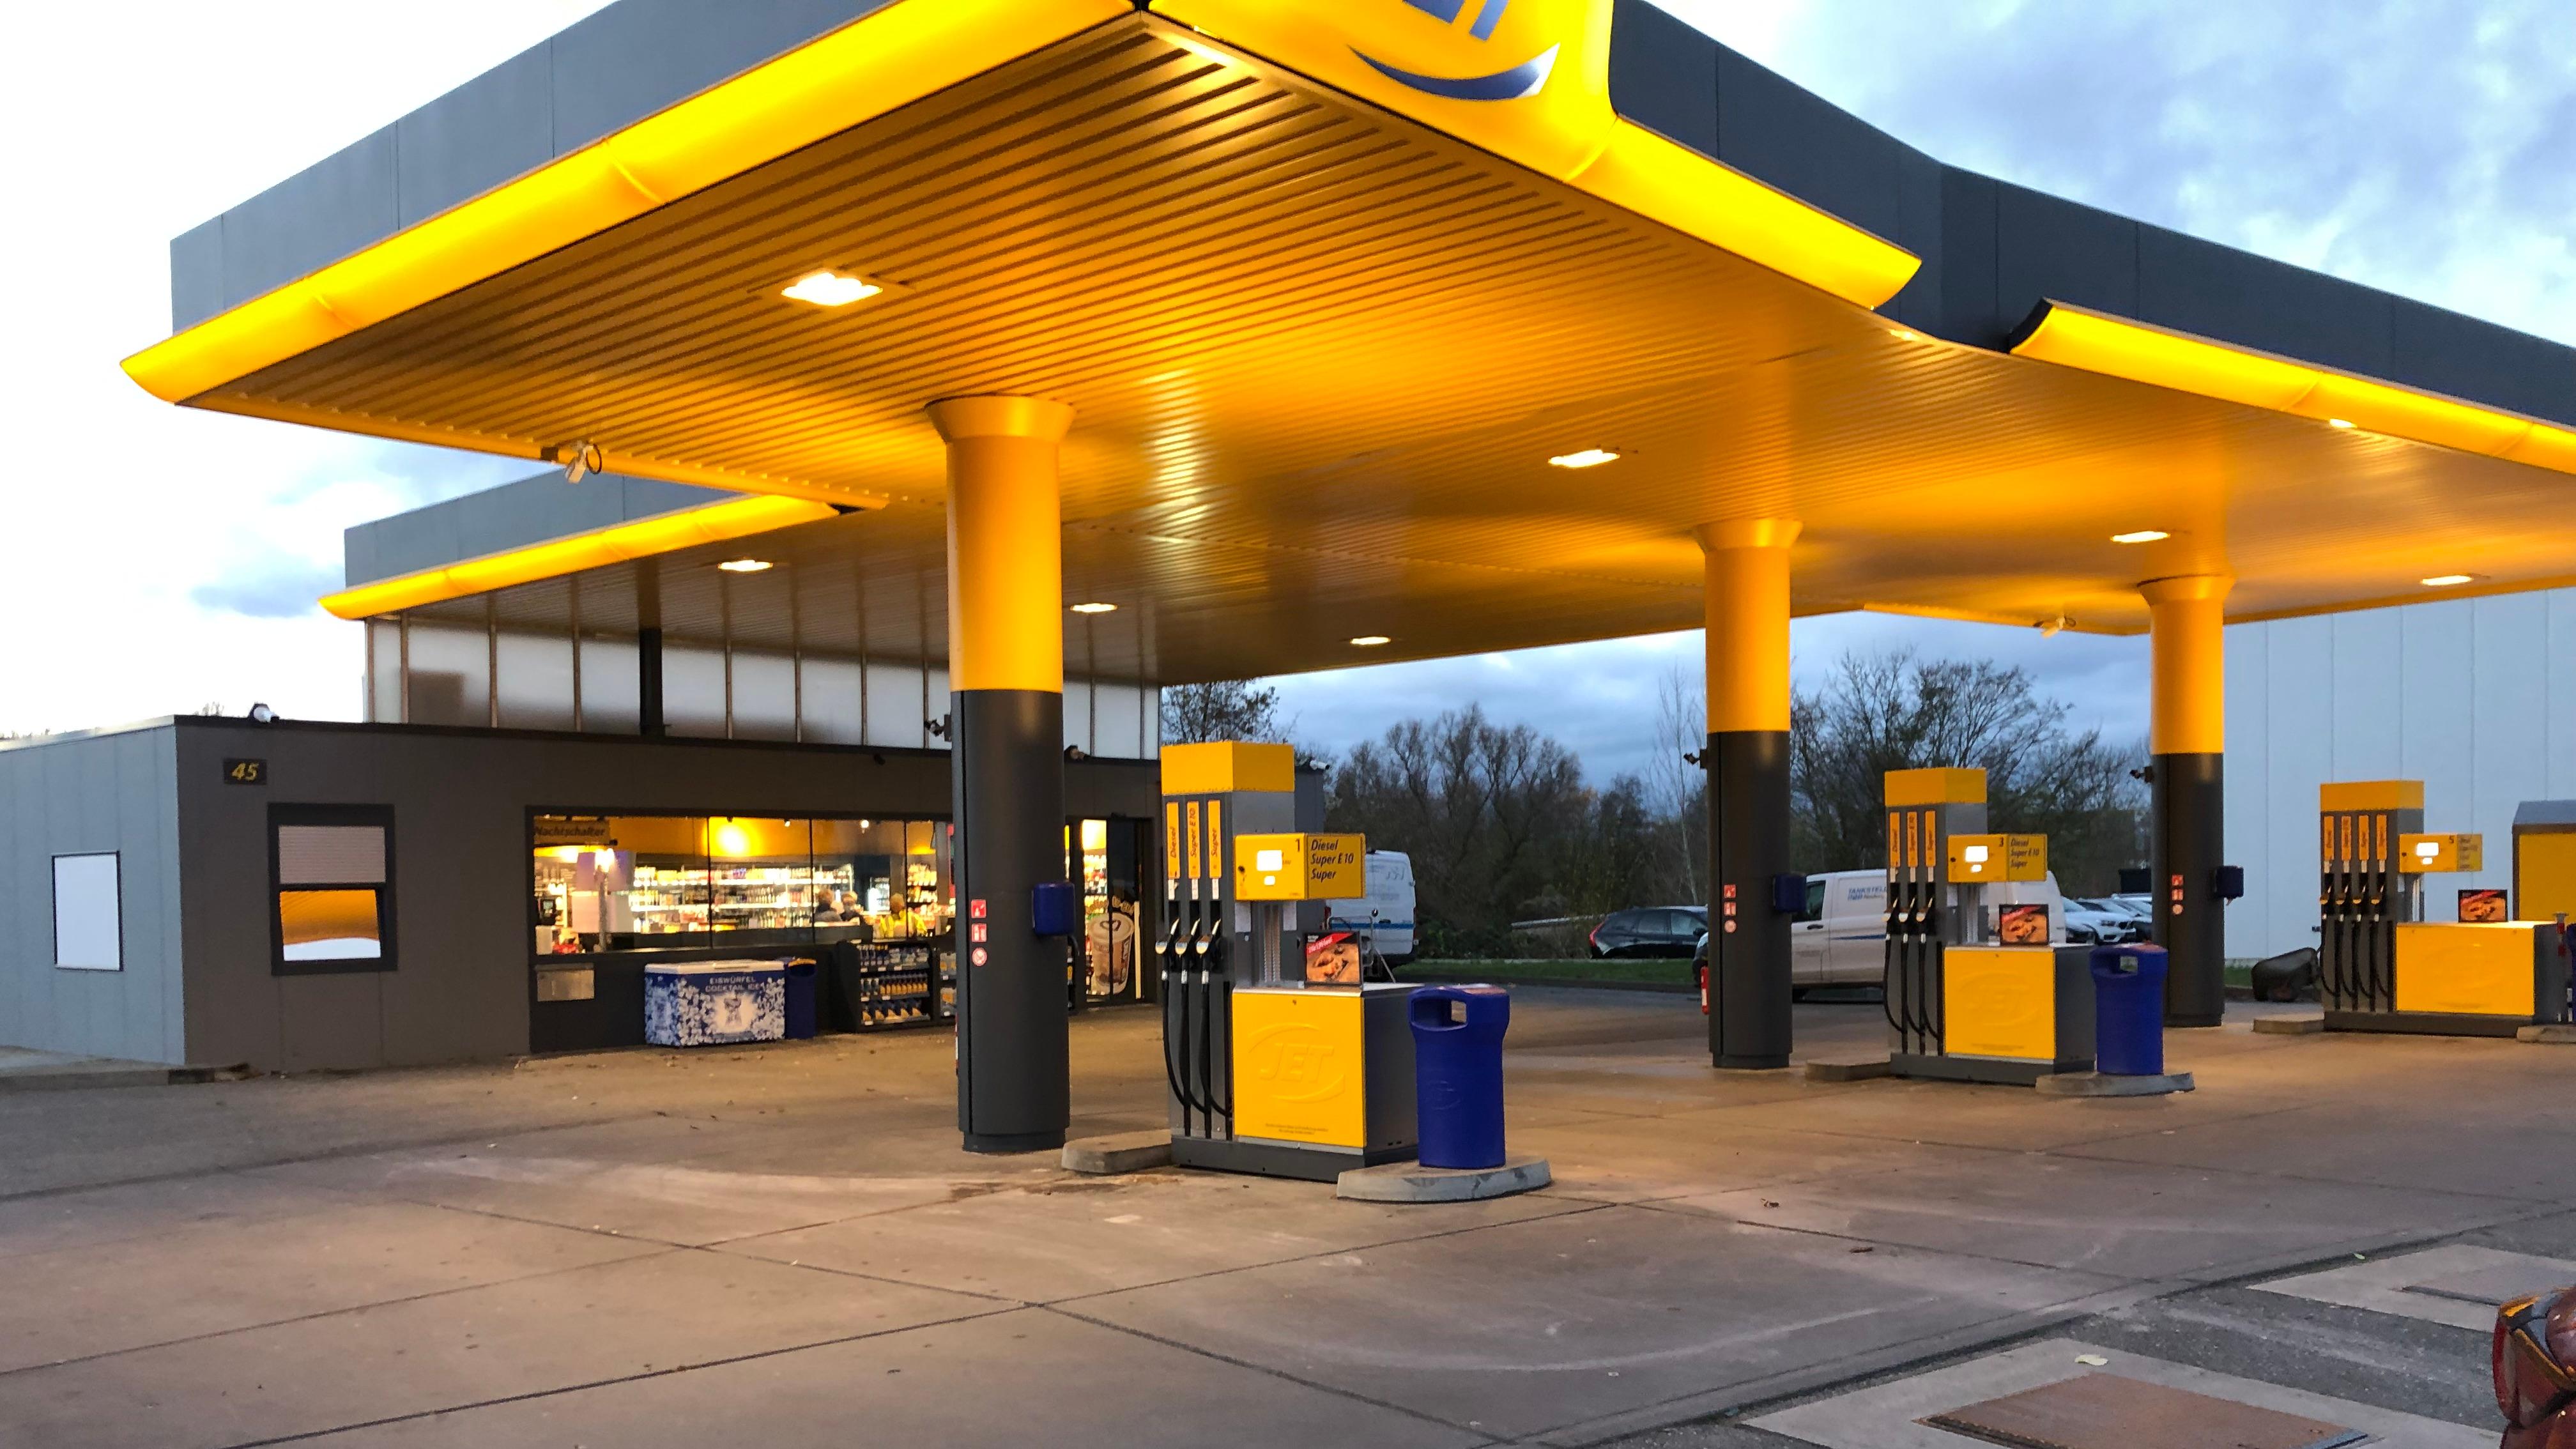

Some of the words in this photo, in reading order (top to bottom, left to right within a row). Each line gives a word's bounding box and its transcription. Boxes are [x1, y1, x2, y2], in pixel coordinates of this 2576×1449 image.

[232, 762, 259, 781] 45
[1295, 838, 1301, 852] 1
[1311, 839, 1339, 851] Diesel
[1998, 837, 2004, 847] 3
[2448, 836, 2455, 844] 5
[1311, 852, 1337, 867] Super
[1311, 868, 1337, 883] Super
[1259, 1041, 1335, 1084] JET
